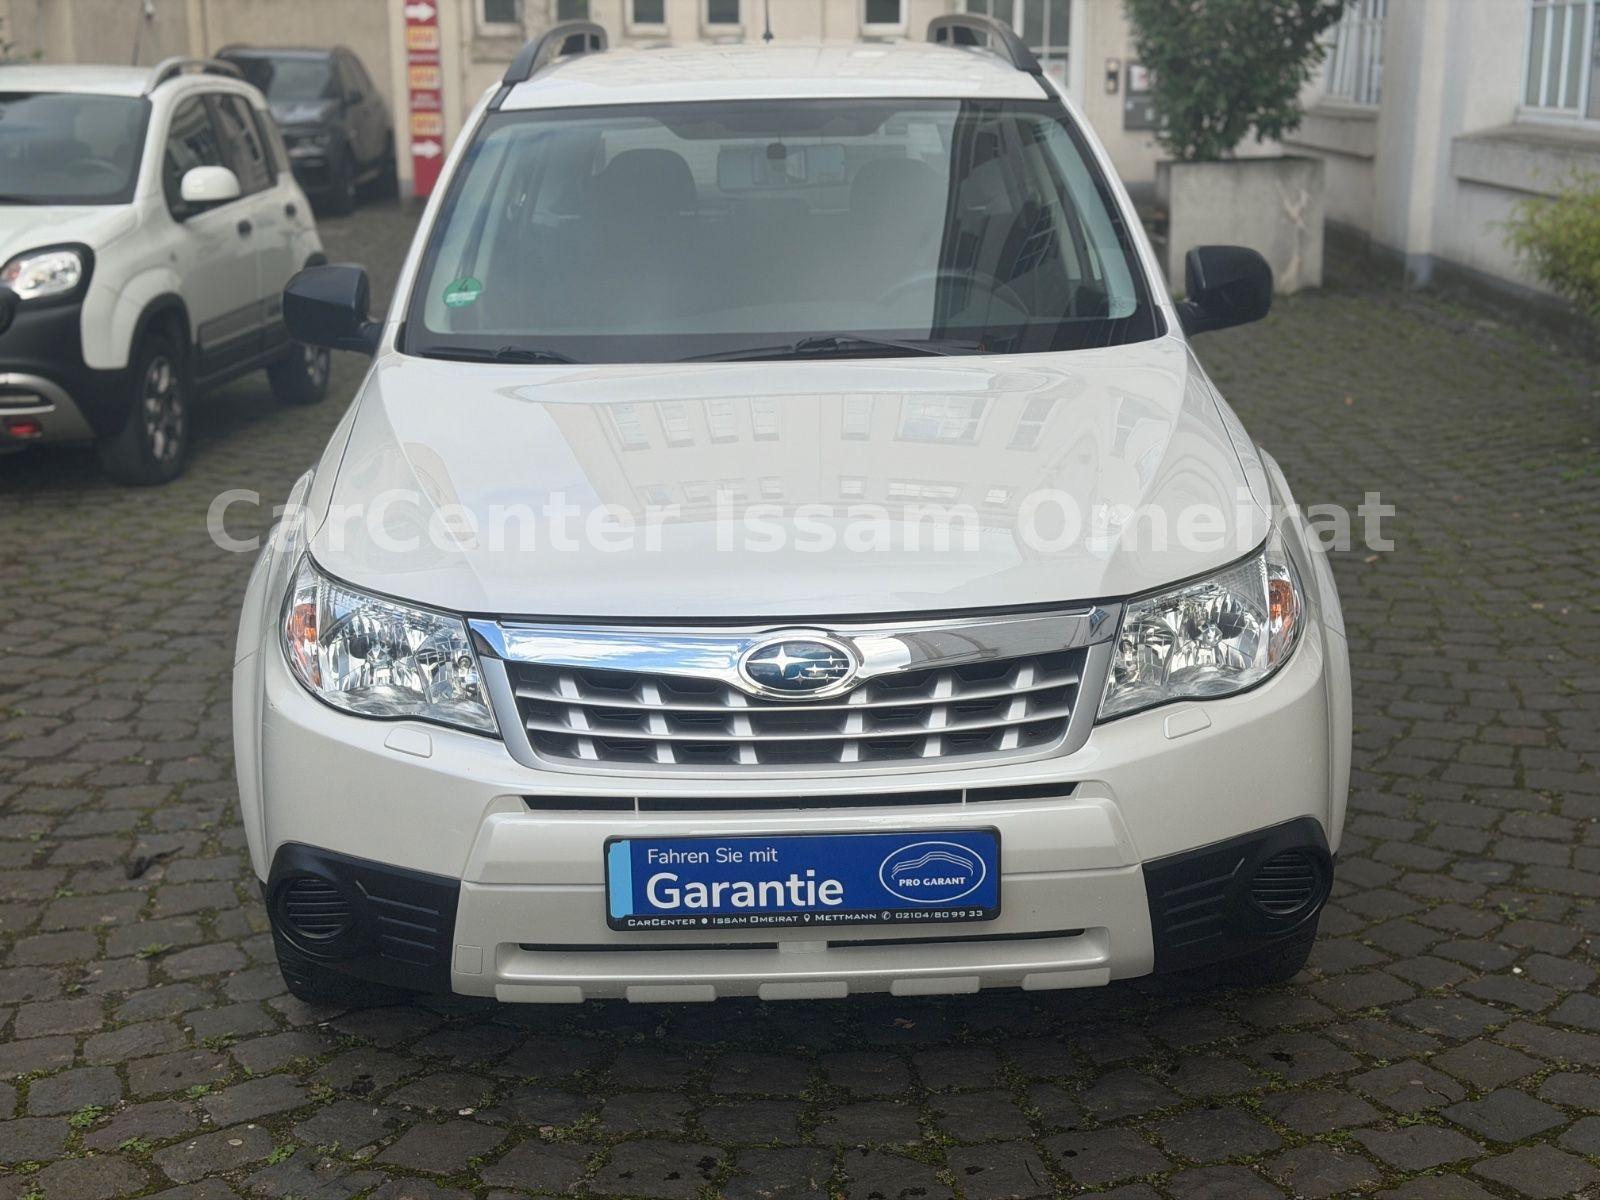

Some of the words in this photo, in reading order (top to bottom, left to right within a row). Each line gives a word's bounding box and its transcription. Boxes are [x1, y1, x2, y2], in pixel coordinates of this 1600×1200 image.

[647, 848, 710, 864] Fahren
[715, 847, 743, 863] Sie
[749, 847, 778, 863] mit
[898, 878, 921, 887] PRO
[923, 877, 966, 886] GARANT
[646, 869, 844, 909] Garantie
[951, 910, 966, 918] 99
[968, 909, 983, 917] 33
